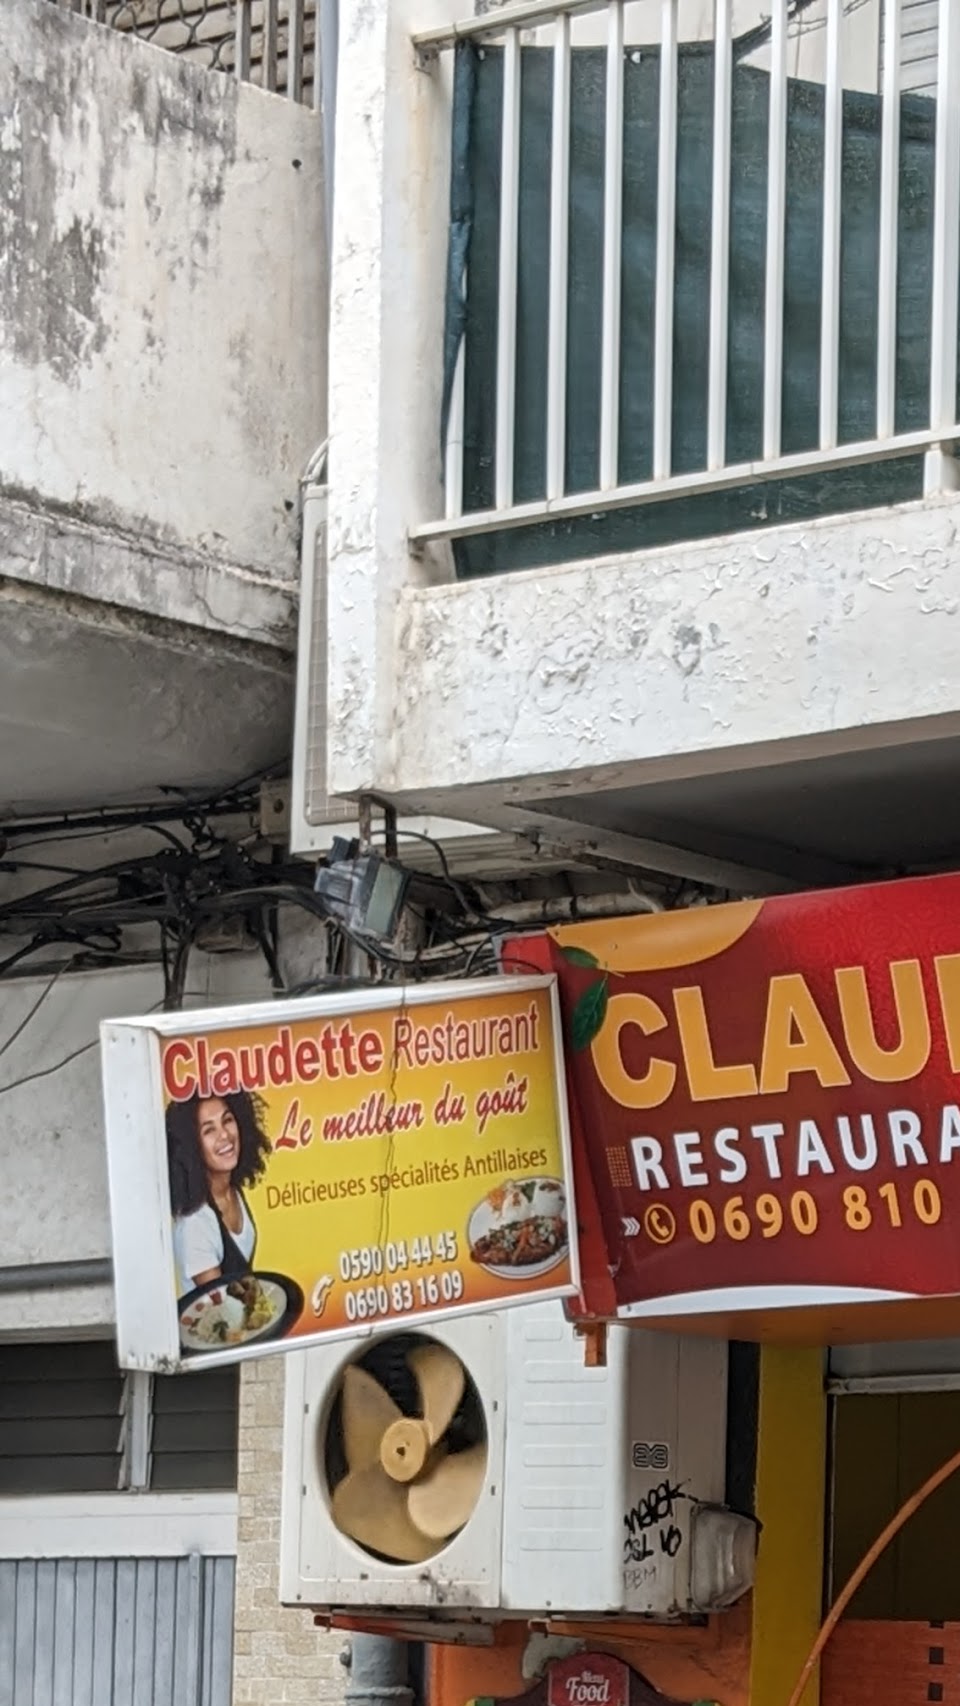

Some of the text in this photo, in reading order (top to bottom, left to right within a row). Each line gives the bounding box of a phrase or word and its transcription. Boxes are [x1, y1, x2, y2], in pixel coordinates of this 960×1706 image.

[163, 1002, 539, 1099] Claudette Restaurant
[275, 1071, 529, 1150] Le meilleur du goût
[266, 1146, 548, 1210] Délicieuses spécialités Antillaises
[689, 1190, 818, 1243] 0690
[842, 1179, 942, 1230] 810
[339, 1231, 458, 1282] 0590 04 44 45
[345, 1269, 463, 1321] 0690 83 16 09
[566, 1677, 611, 1701] Food
